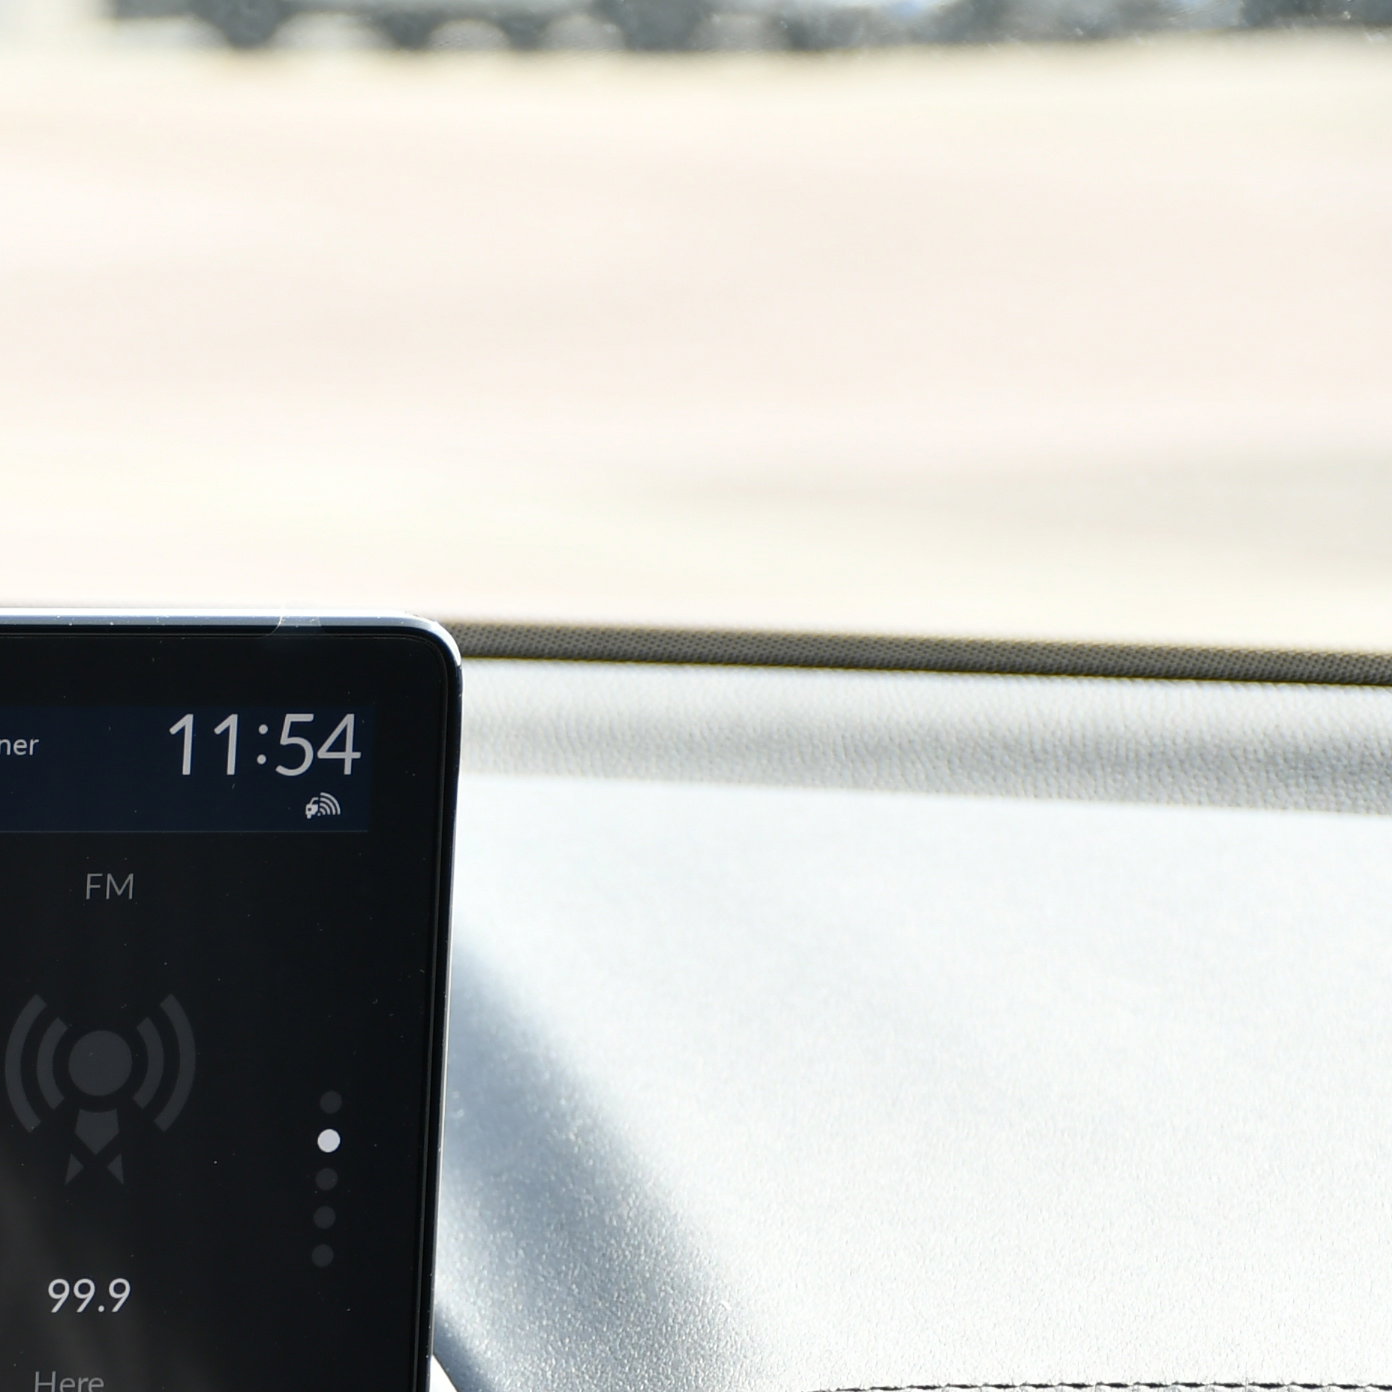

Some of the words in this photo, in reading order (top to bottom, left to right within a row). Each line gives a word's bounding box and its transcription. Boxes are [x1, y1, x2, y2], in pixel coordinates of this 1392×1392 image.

[169, 713, 361, 776] 11:54
[85, 872, 135, 900] FM
[47, 1278, 131, 1313] 99.9
